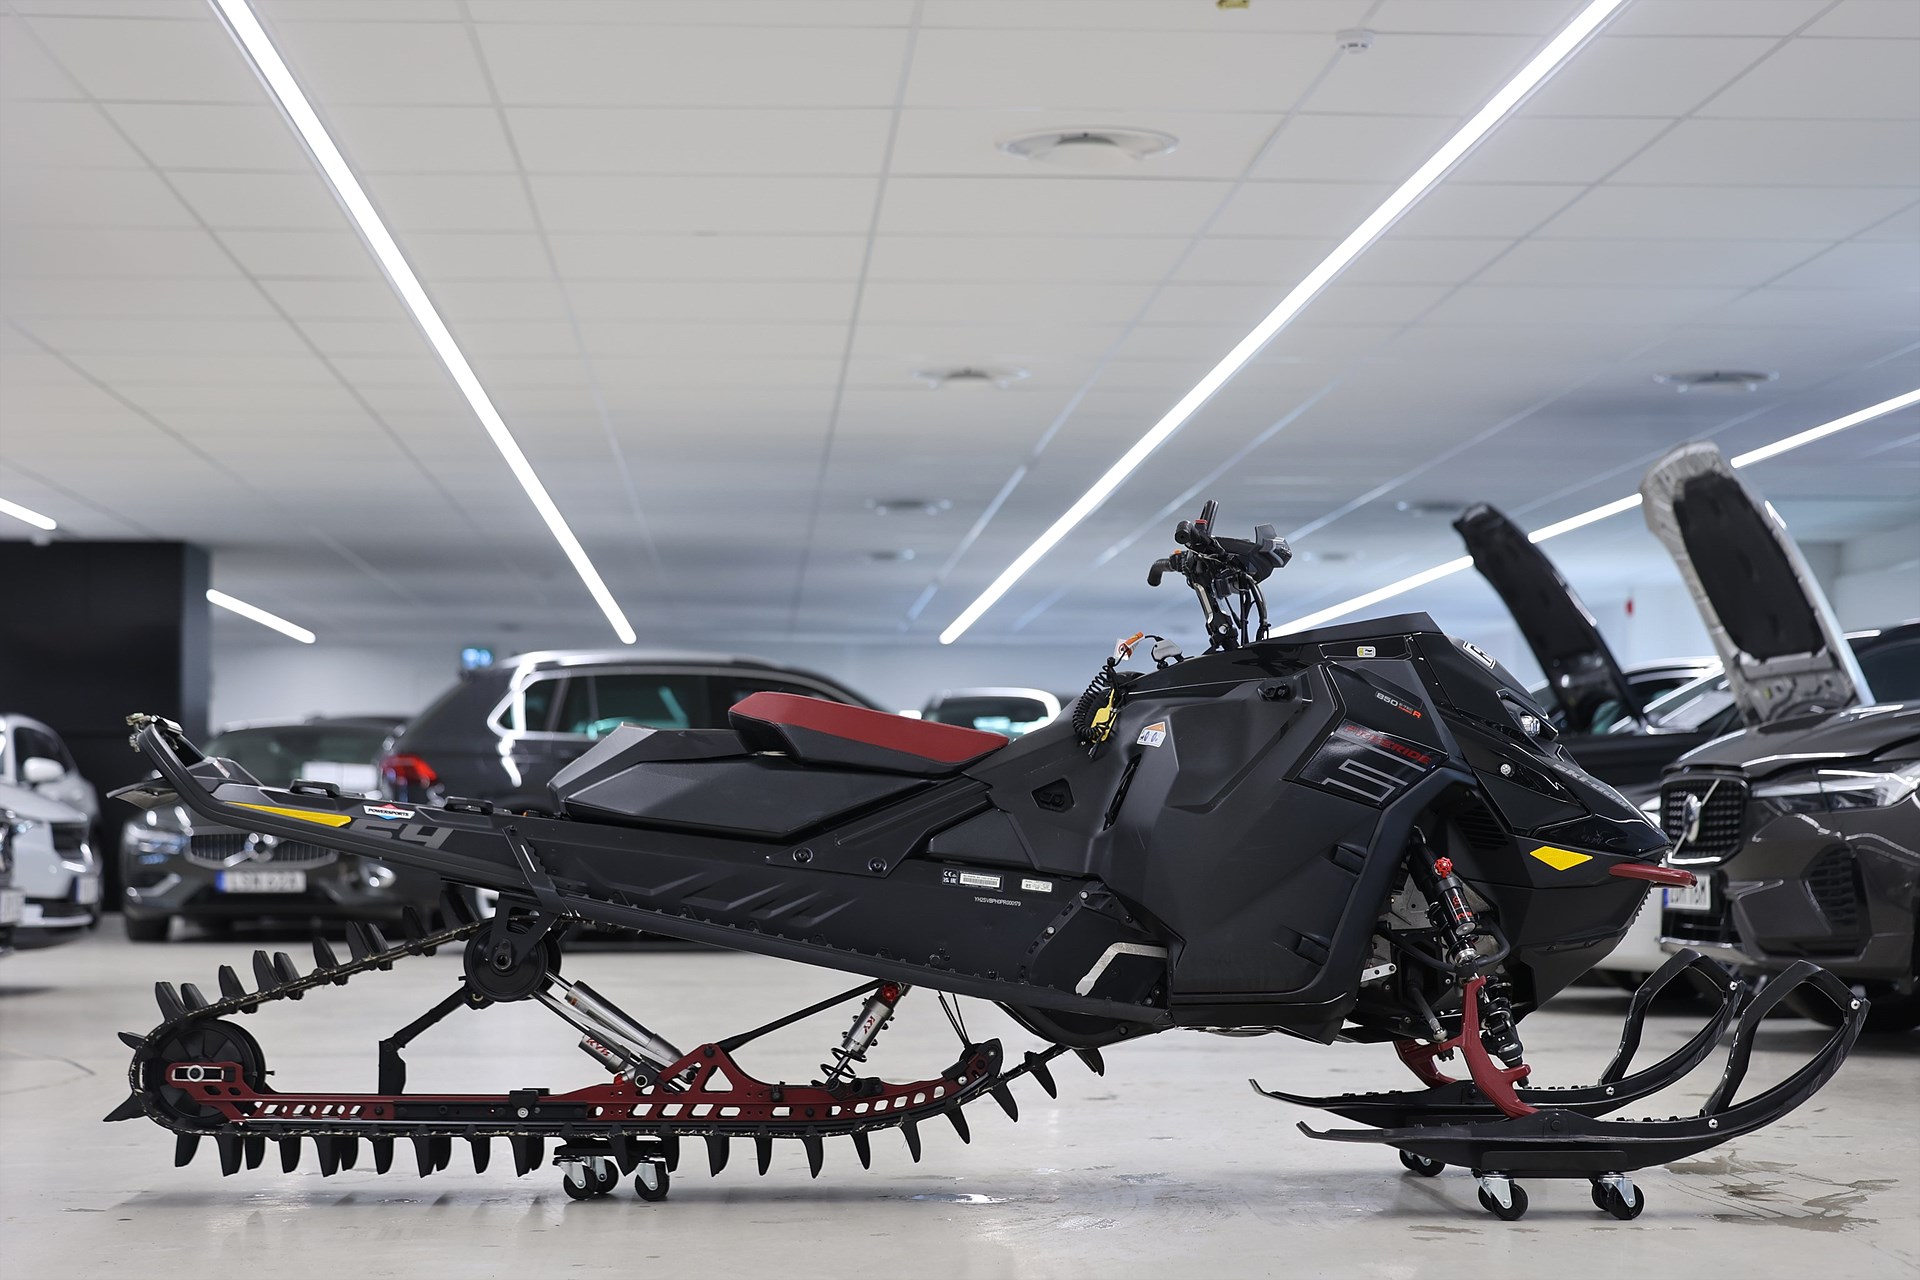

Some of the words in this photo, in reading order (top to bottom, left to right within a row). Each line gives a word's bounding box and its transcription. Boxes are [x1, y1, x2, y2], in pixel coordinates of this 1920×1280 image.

[1376, 692, 1399, 707] 850
[1412, 710, 1422, 719] R
[1344, 724, 1433, 766] FREERIDE
[367, 807, 410, 817] POWERSPORTS
